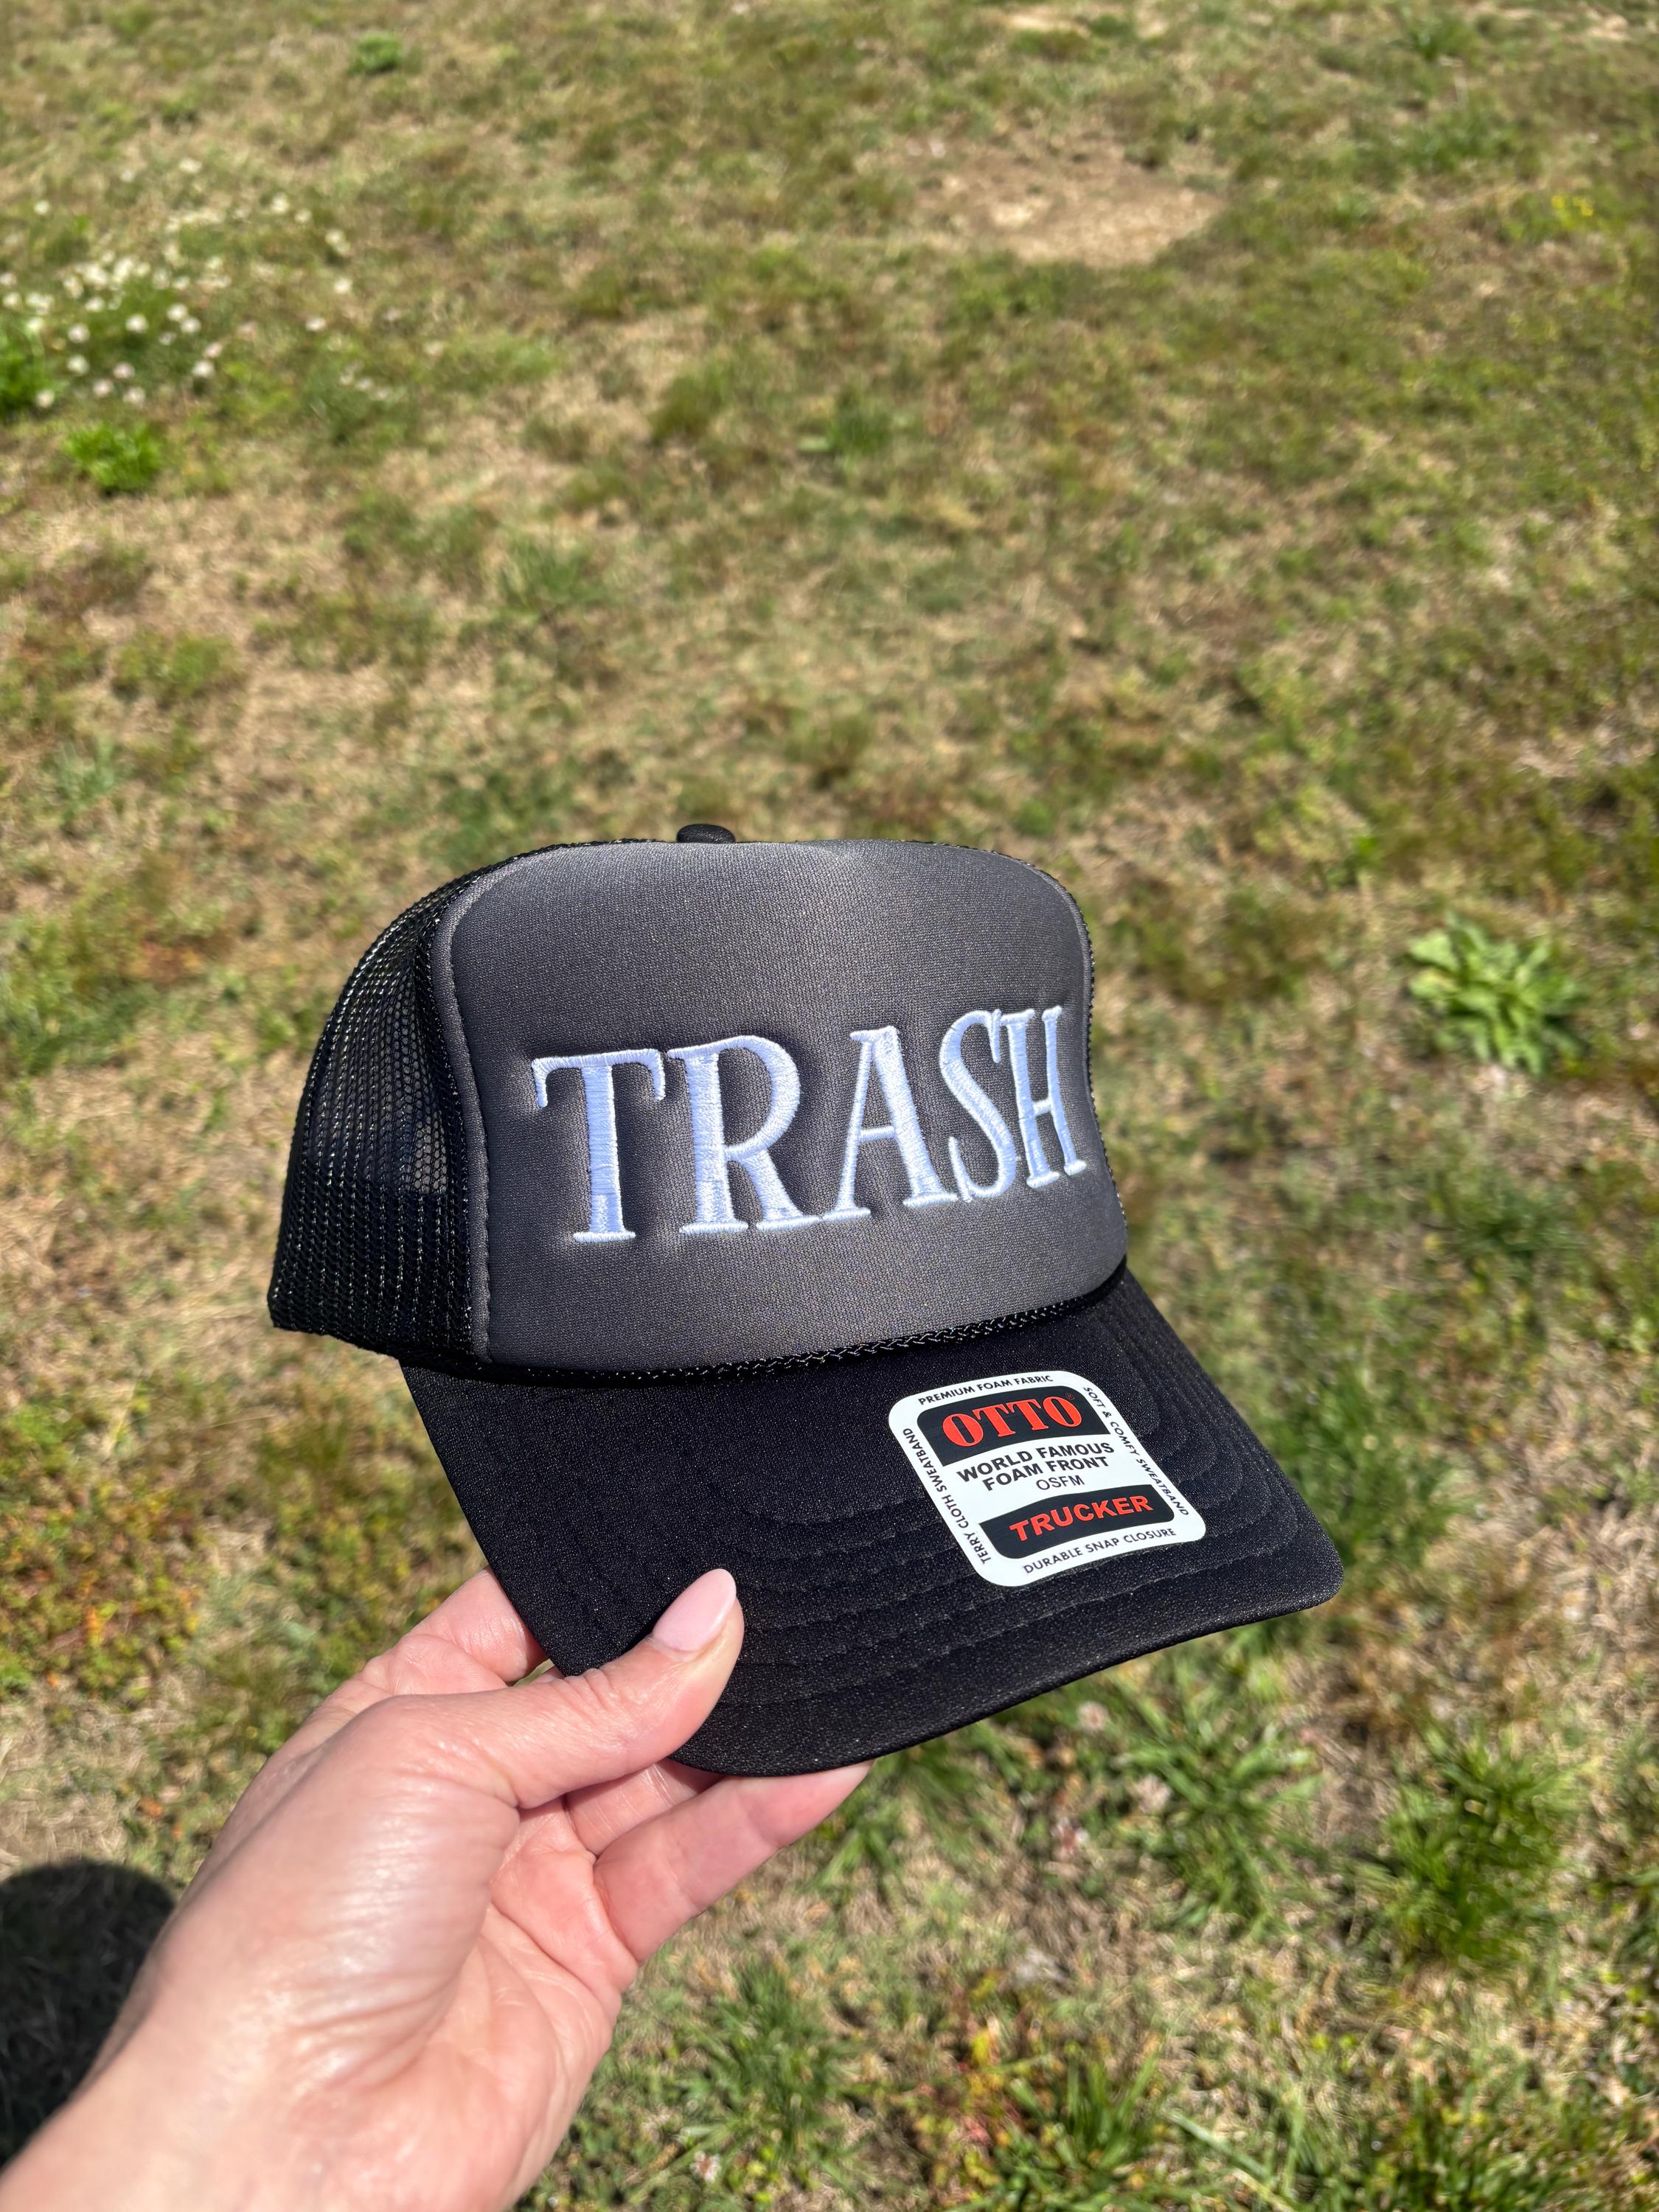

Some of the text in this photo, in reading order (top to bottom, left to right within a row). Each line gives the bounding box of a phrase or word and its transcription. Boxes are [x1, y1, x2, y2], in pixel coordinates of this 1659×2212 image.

[530, 1005, 1087, 1243] TRASH
[918, 1375, 1054, 1405] PREMIUM FOAM FABRIC
[942, 1396, 1082, 1447] OTTO
[957, 1442, 1115, 1484] WORLD FAMOUS
[981, 1456, 1110, 1492] FOAM FRONT
[1084, 1387, 1105, 1408] SOFT
[1110, 1421, 1138, 1455] COMFY
[1136, 1458, 1189, 1516] SWEATBAND
[902, 1427, 992, 1564] TERRY CLOTH SWEATBAND
[1035, 1475, 1085, 1490] OSFM
[1009, 1495, 1154, 1542] TRUCKER
[1023, 1528, 1176, 1574] DURABLE SNAP CLOSURE
